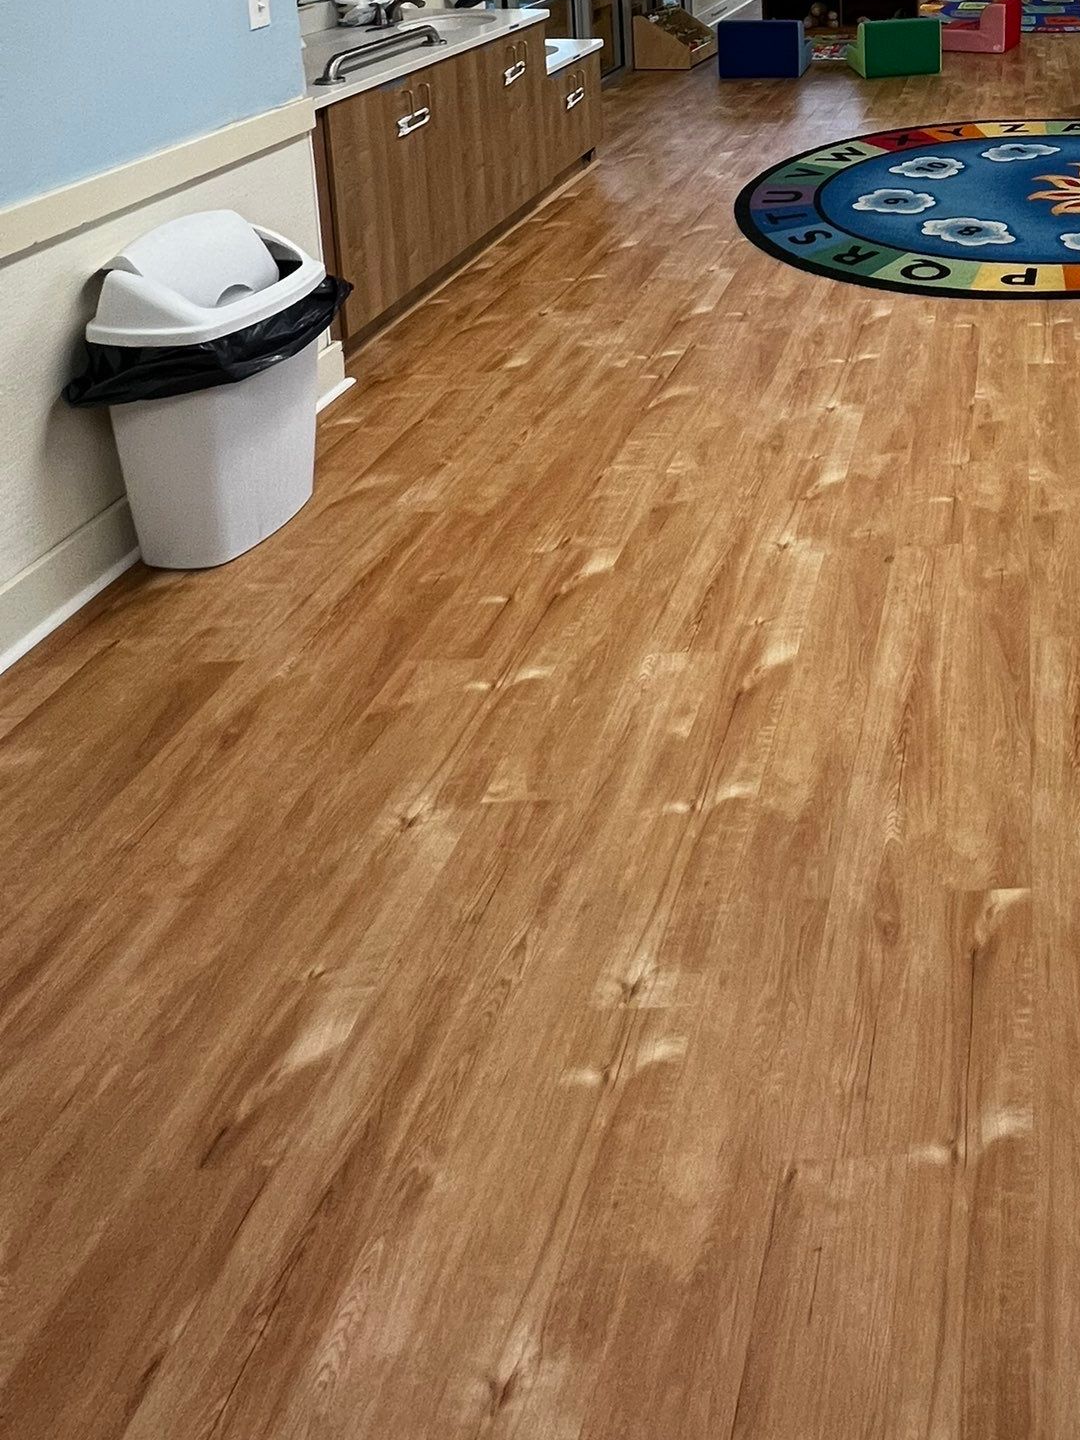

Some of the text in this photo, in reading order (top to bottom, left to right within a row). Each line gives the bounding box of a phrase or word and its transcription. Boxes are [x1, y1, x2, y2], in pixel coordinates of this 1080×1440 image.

[937, 127, 963, 136] Y
[1000, 123, 1029, 133] Z
[886, 133, 923, 146] X
[815, 146, 867, 162] W
[785, 168, 825, 178] V
[915, 162, 948, 172] 10
[762, 190, 803, 204] U
[766, 213, 808, 225] T
[788, 229, 833, 245] S
[957, 226, 983, 236] 8
[832, 245, 880, 266] R
[900, 259, 951, 281] Q
[1000, 267, 1038, 286] P
